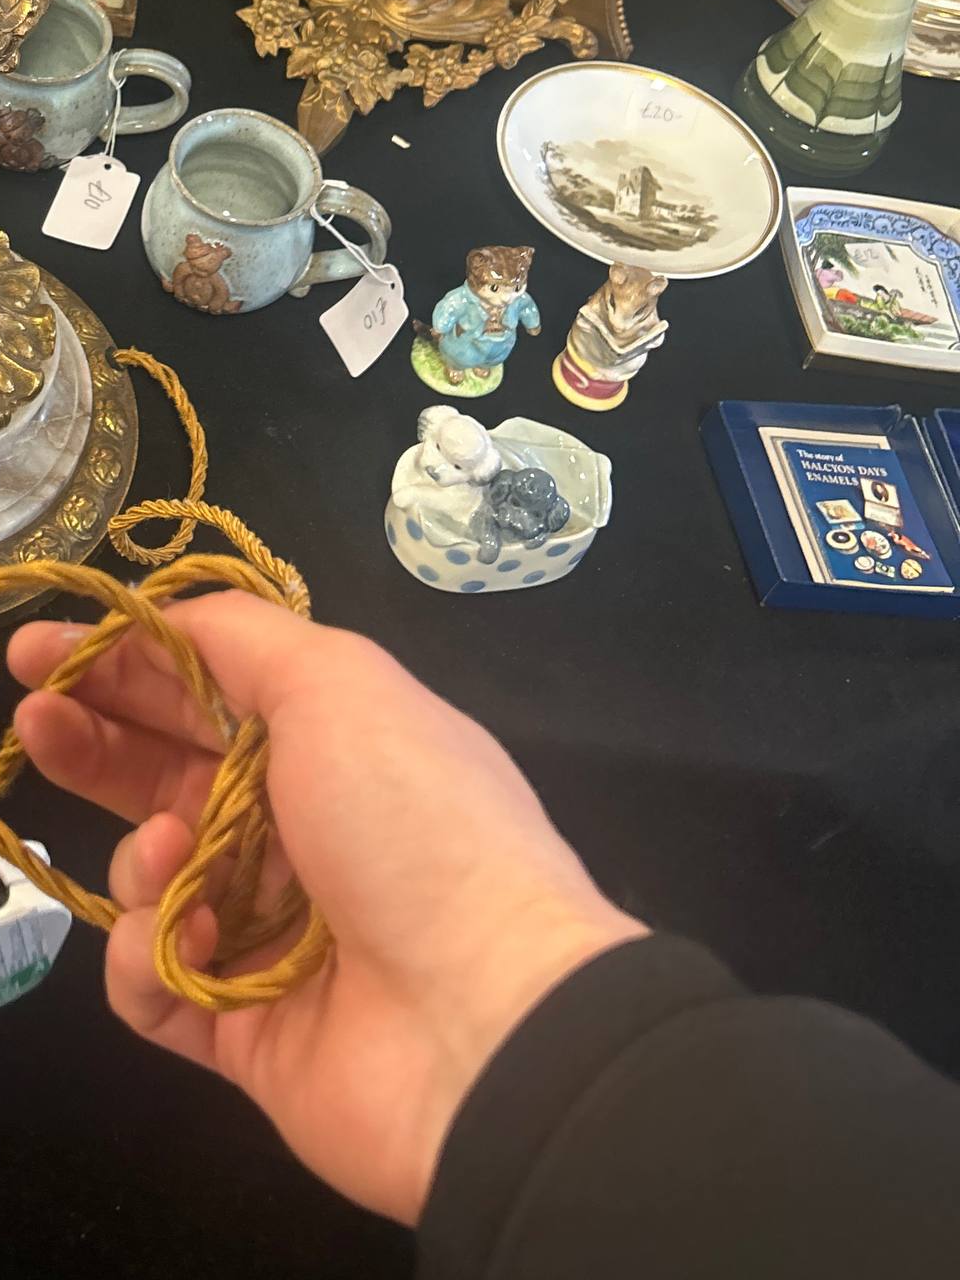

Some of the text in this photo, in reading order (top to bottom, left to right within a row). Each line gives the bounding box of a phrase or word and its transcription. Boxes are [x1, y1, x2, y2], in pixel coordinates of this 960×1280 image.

[801, 460, 888, 477] HALCYON DAYS
[806, 472, 859, 487] ENAMELS
